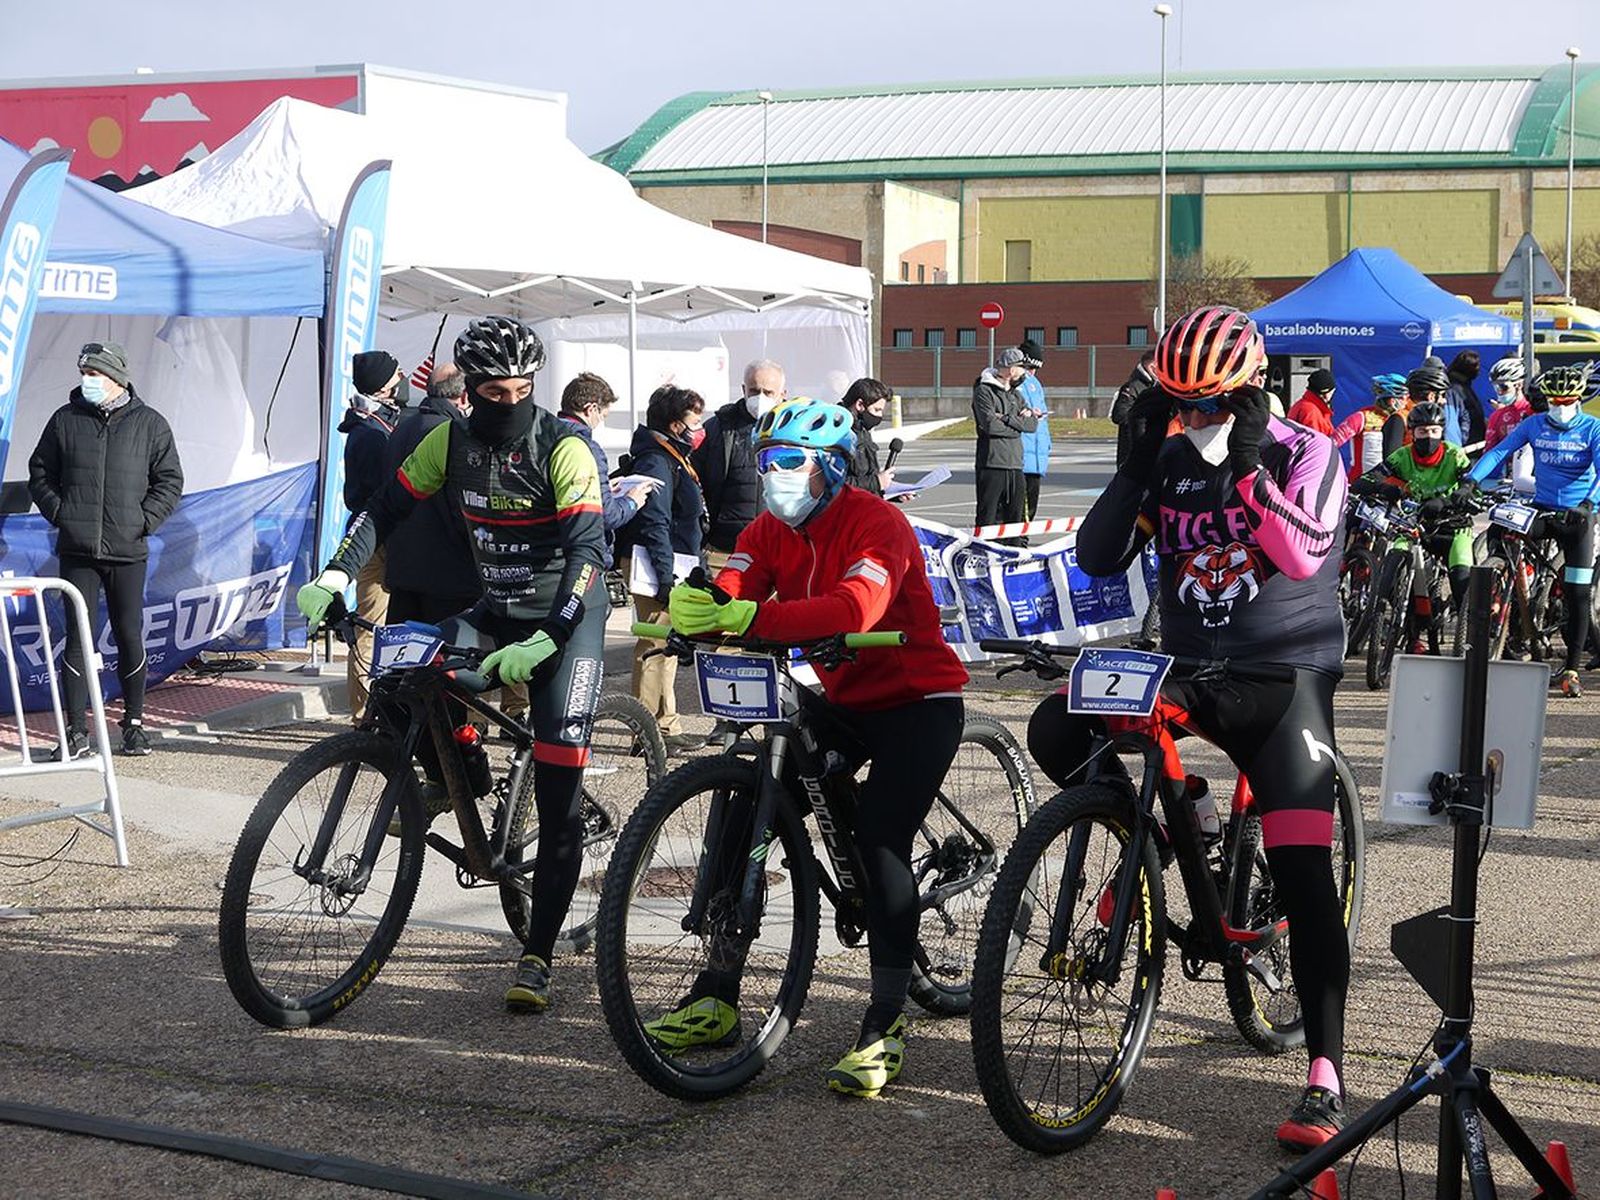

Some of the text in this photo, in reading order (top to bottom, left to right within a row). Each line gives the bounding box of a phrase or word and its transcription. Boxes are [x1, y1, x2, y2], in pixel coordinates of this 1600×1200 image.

[1265, 323, 1375, 337] bacalaobueno.es
[394, 645, 408, 662] 6
[1105, 673, 1121, 696] 2
[727, 682, 741, 705] 1
[1081, 701, 1140, 711] www.racetime.es
